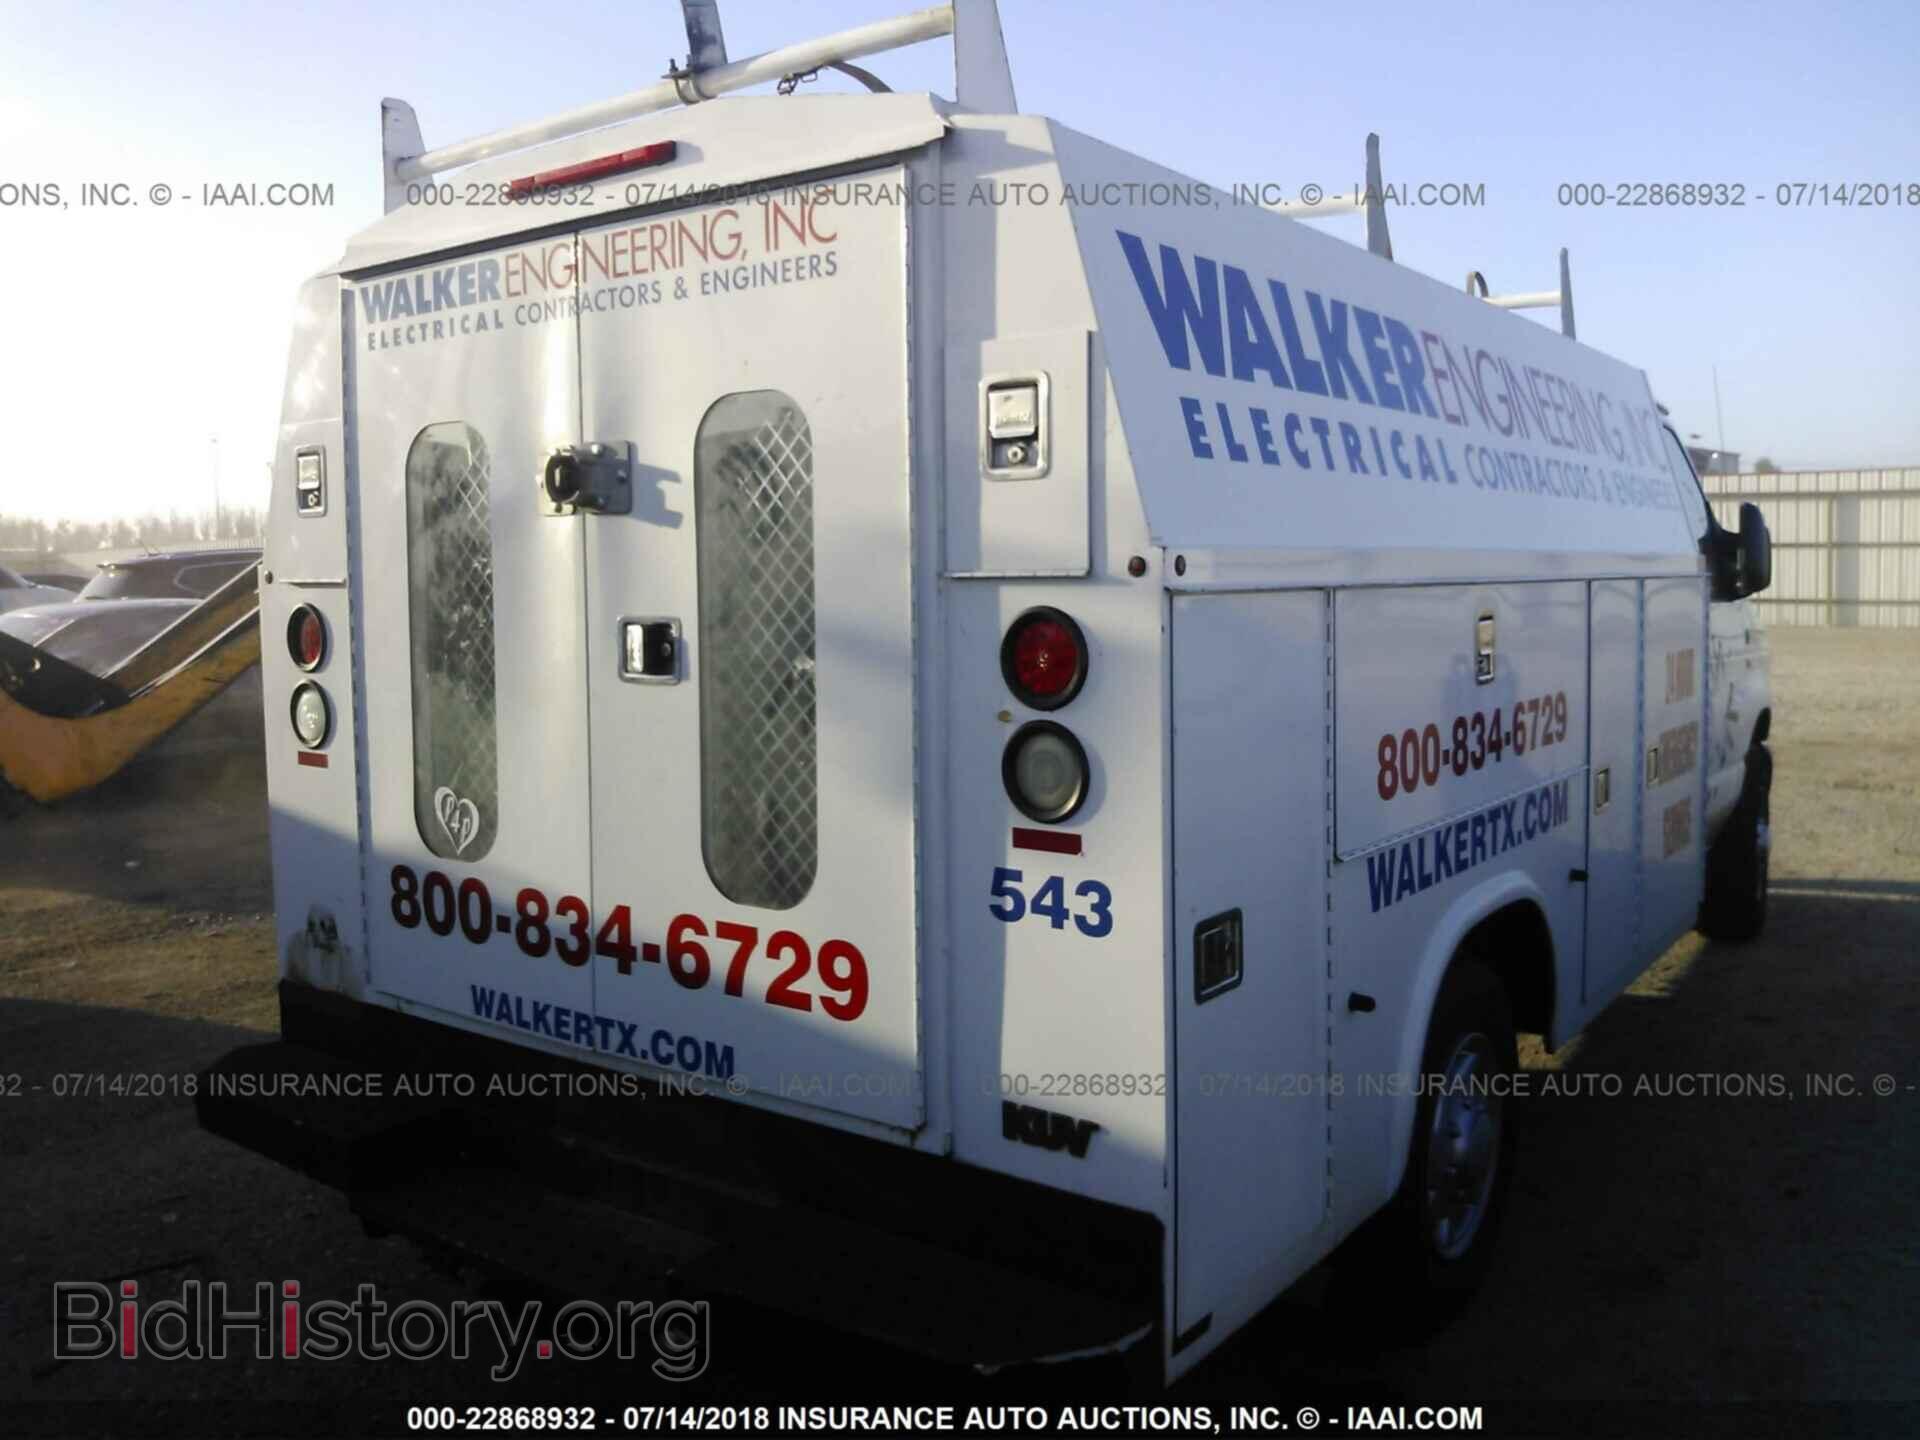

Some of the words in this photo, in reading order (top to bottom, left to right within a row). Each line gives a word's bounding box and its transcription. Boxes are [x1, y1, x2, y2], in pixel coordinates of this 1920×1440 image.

[763, 188, 838, 252] INC
[367, 308, 504, 351] ELECTRICAL
[514, 274, 663, 328] CONTRACTORS
[674, 276, 690, 301] &
[701, 250, 839, 296] ENGINEERS
[1179, 395, 1459, 486] ELECTRICAL
[1463, 442, 1598, 503] CONTRACTORS
[1377, 691, 1568, 801] 800-834-6729
[1366, 780, 1568, 913] WALKERTX.COM
[390, 865, 869, 1022] 800-834-6729
[989, 866, 1113, 938] 543
[470, 984, 735, 1079] WALKERTX.COM
